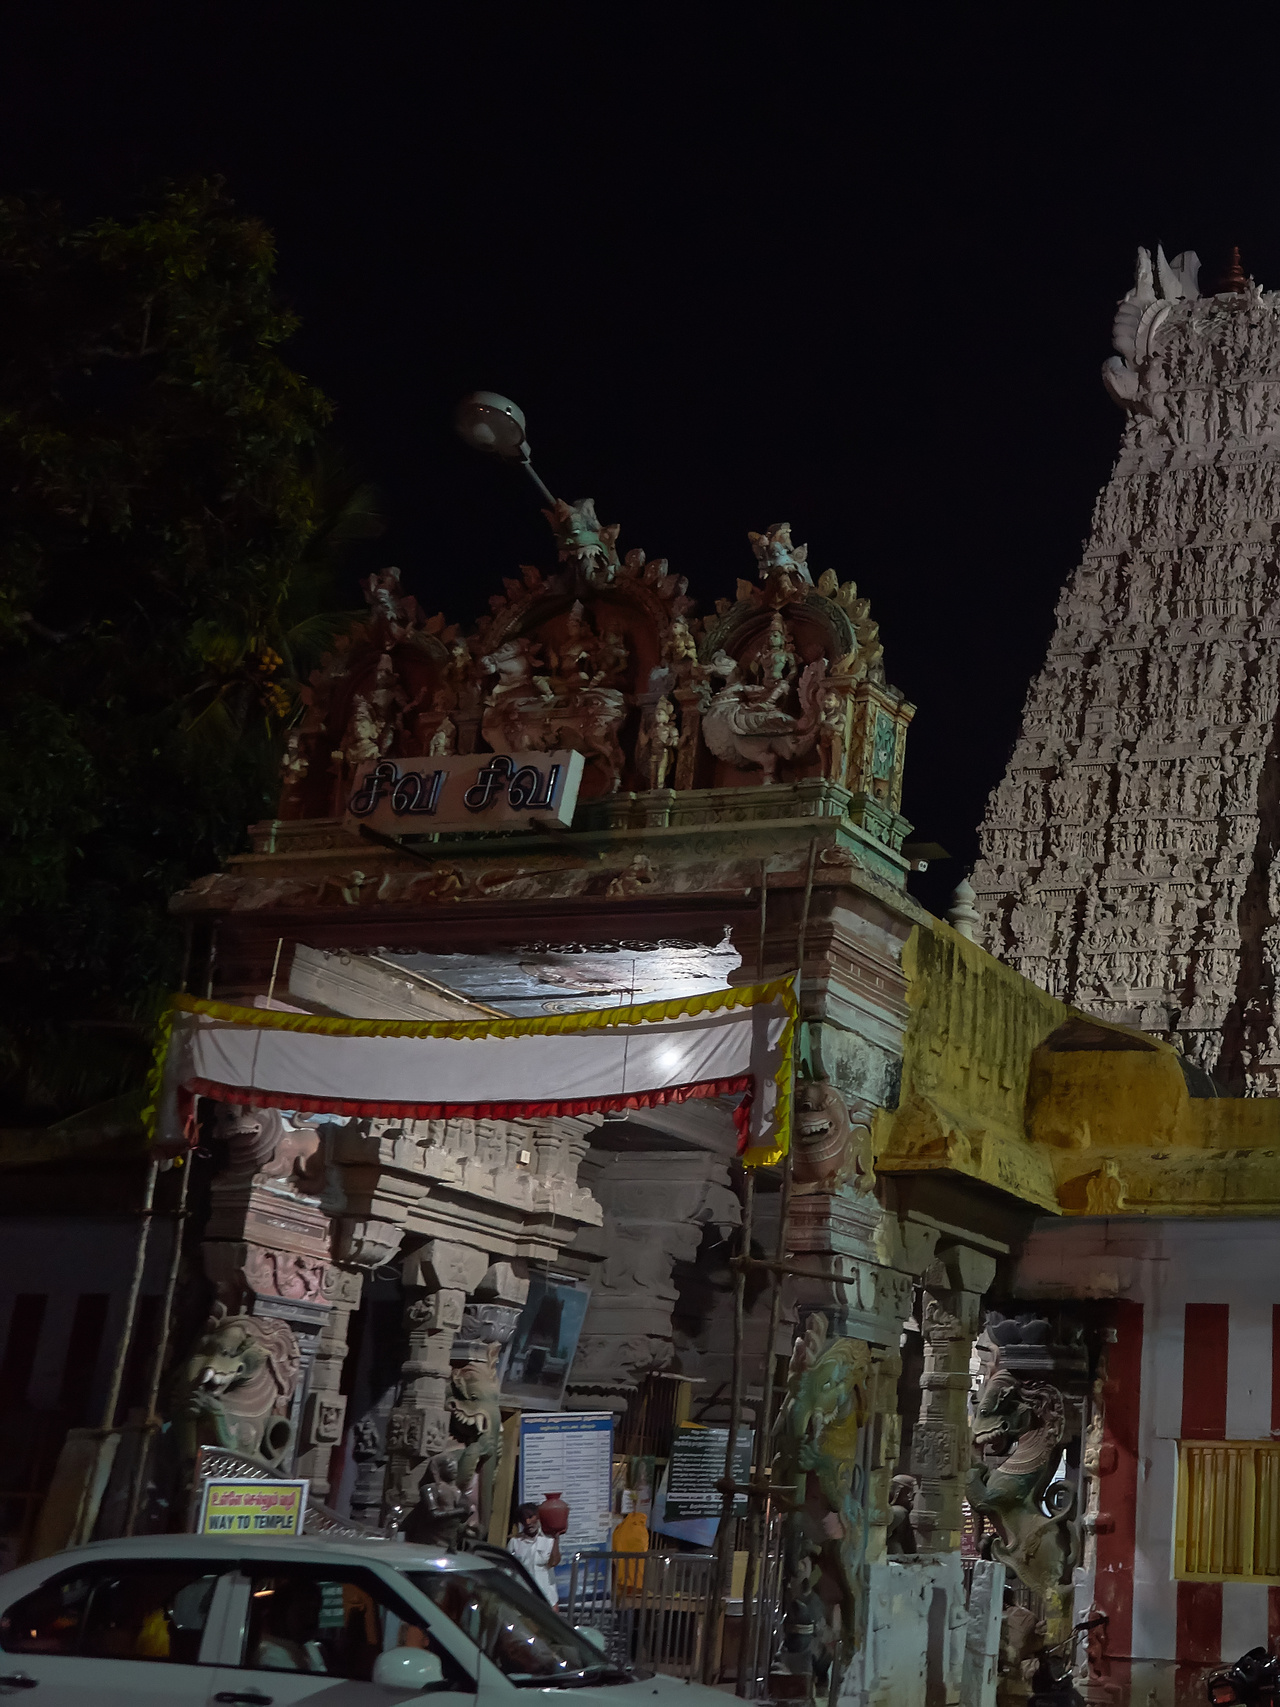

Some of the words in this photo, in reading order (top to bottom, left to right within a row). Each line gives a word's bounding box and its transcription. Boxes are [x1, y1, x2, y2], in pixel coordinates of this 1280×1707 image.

[350, 761, 444, 816] சிவ
[463, 755, 561, 810] சிவ
[280, 1491, 295, 1510] வழி
[209, 1515, 234, 1529] WAY
[237, 1515, 250, 1528] TO
[254, 1515, 293, 1528] TEMPLE
